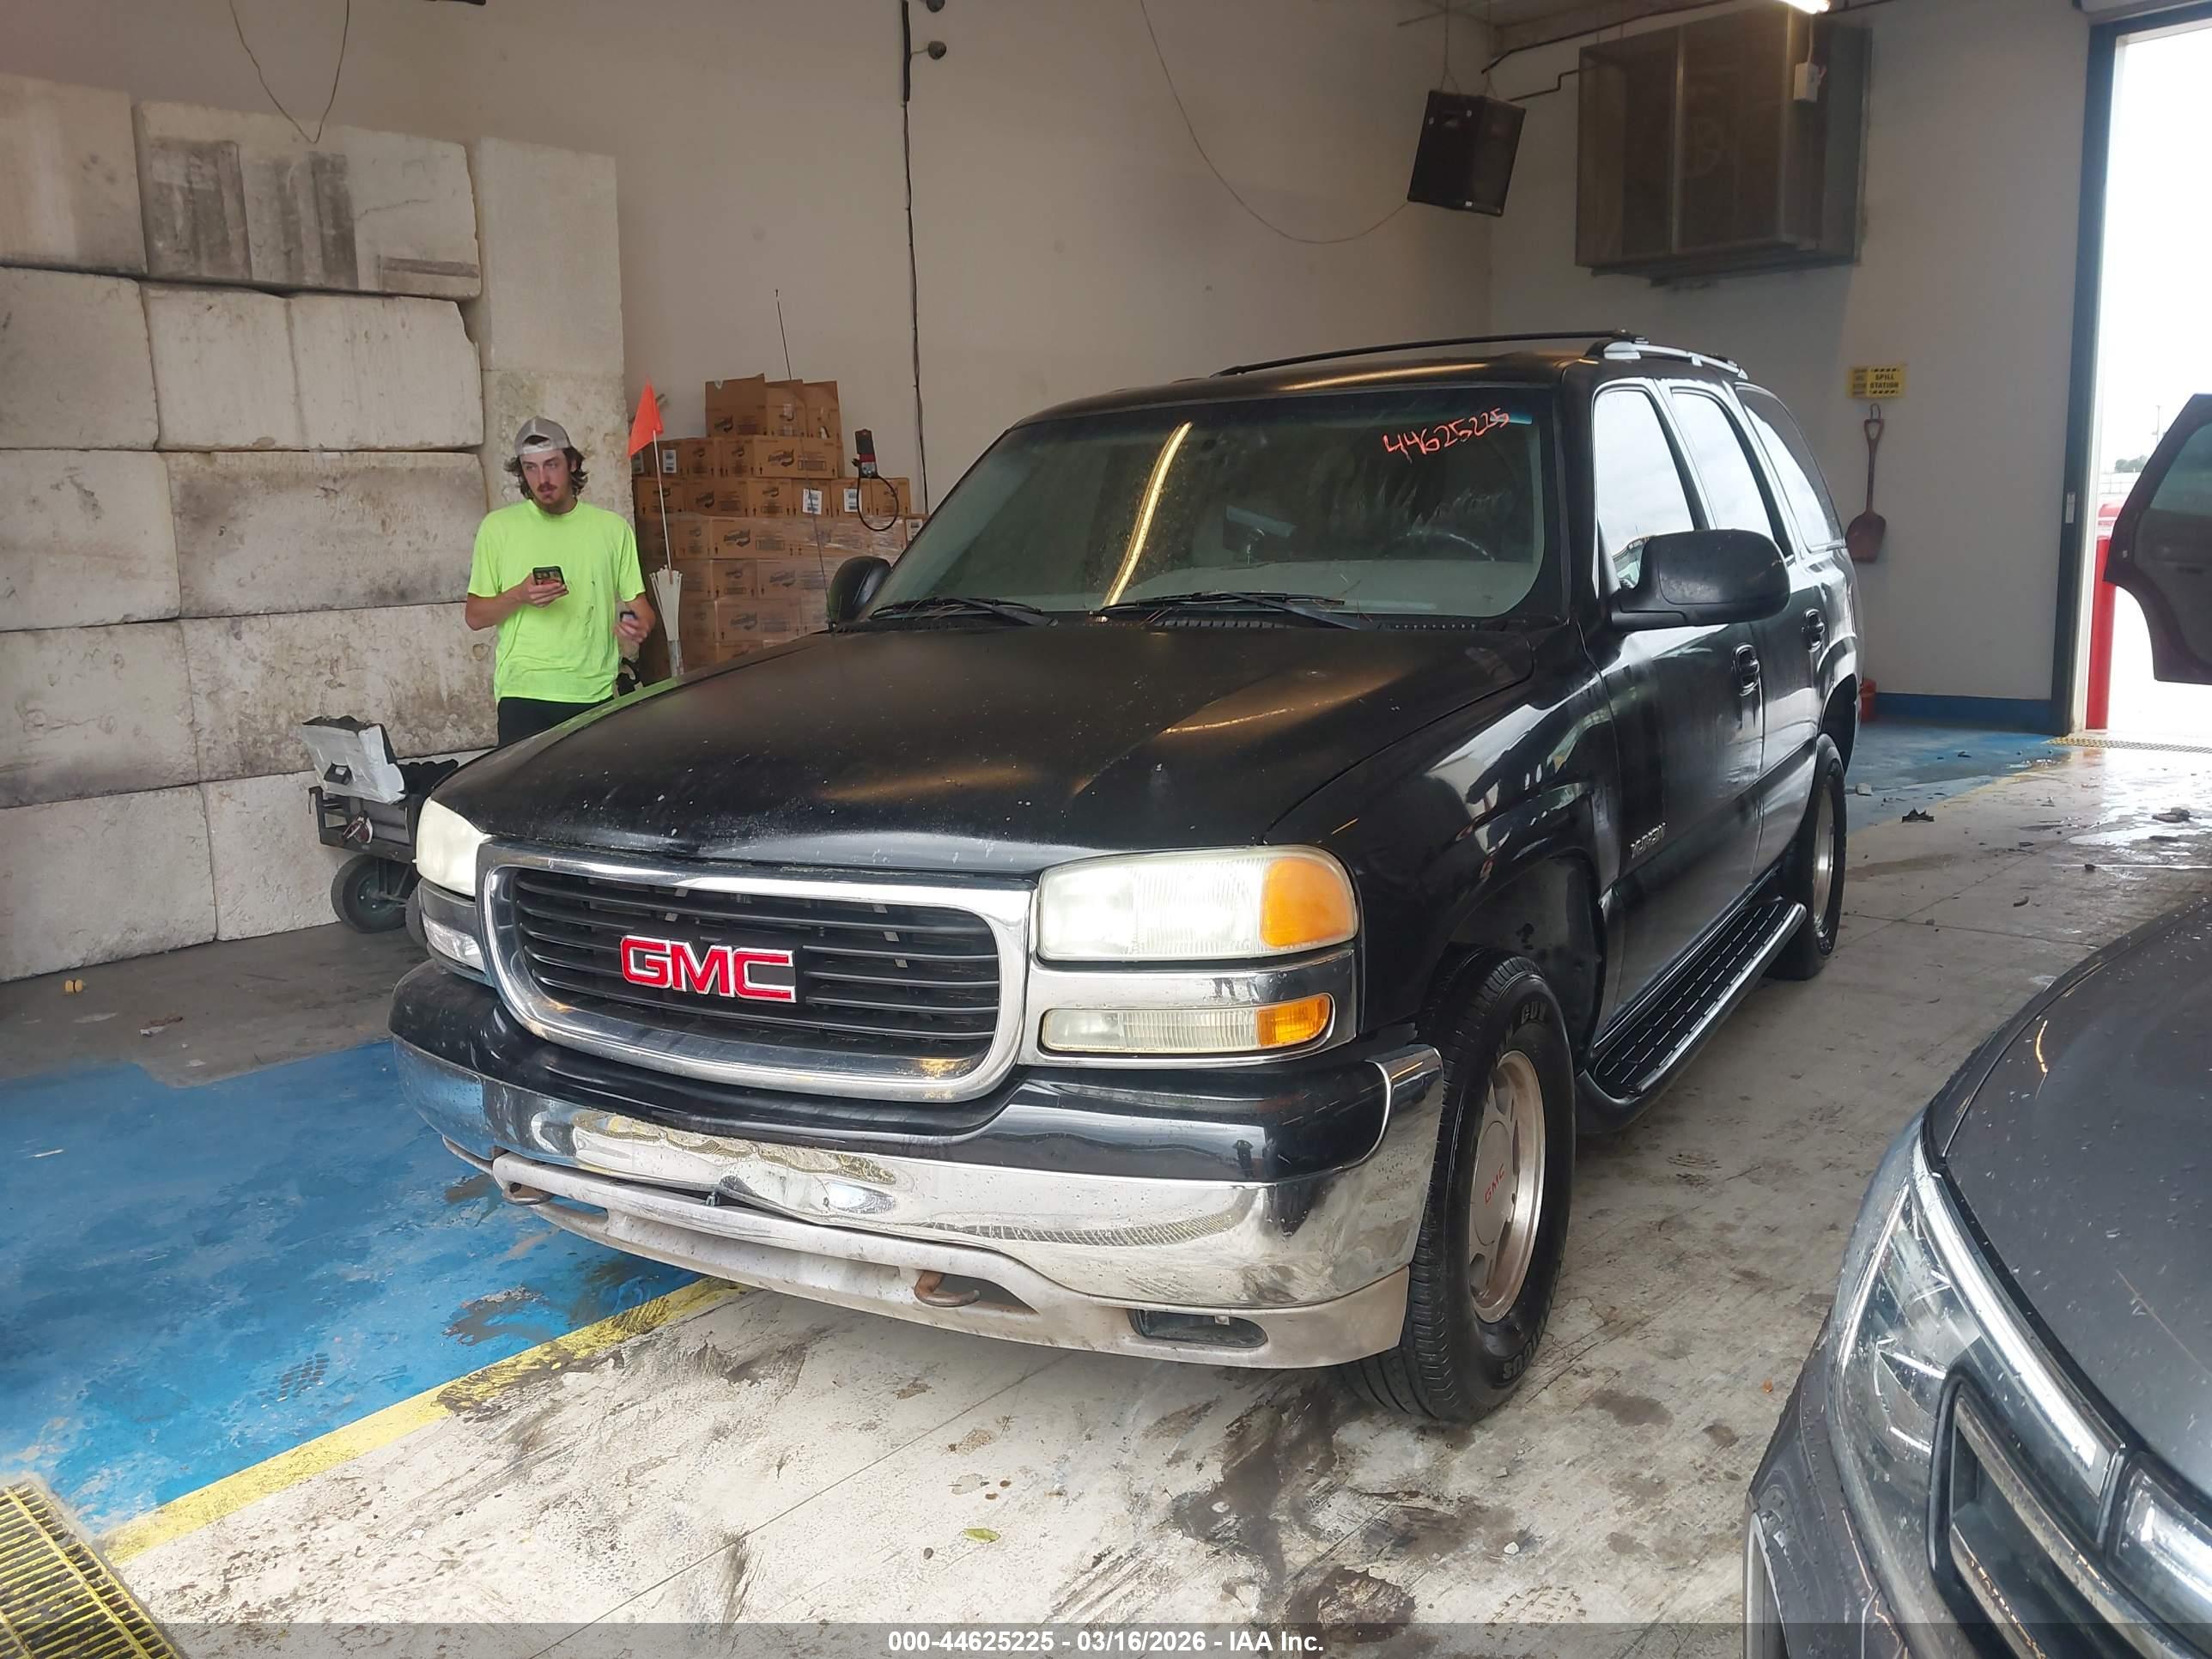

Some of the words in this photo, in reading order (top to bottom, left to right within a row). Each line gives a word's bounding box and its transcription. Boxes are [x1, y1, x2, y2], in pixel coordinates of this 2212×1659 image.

[1382, 408, 1510, 464] 44625225
[620, 934, 797, 1003] GMC
[1485, 1163, 1505, 1204] GMC
